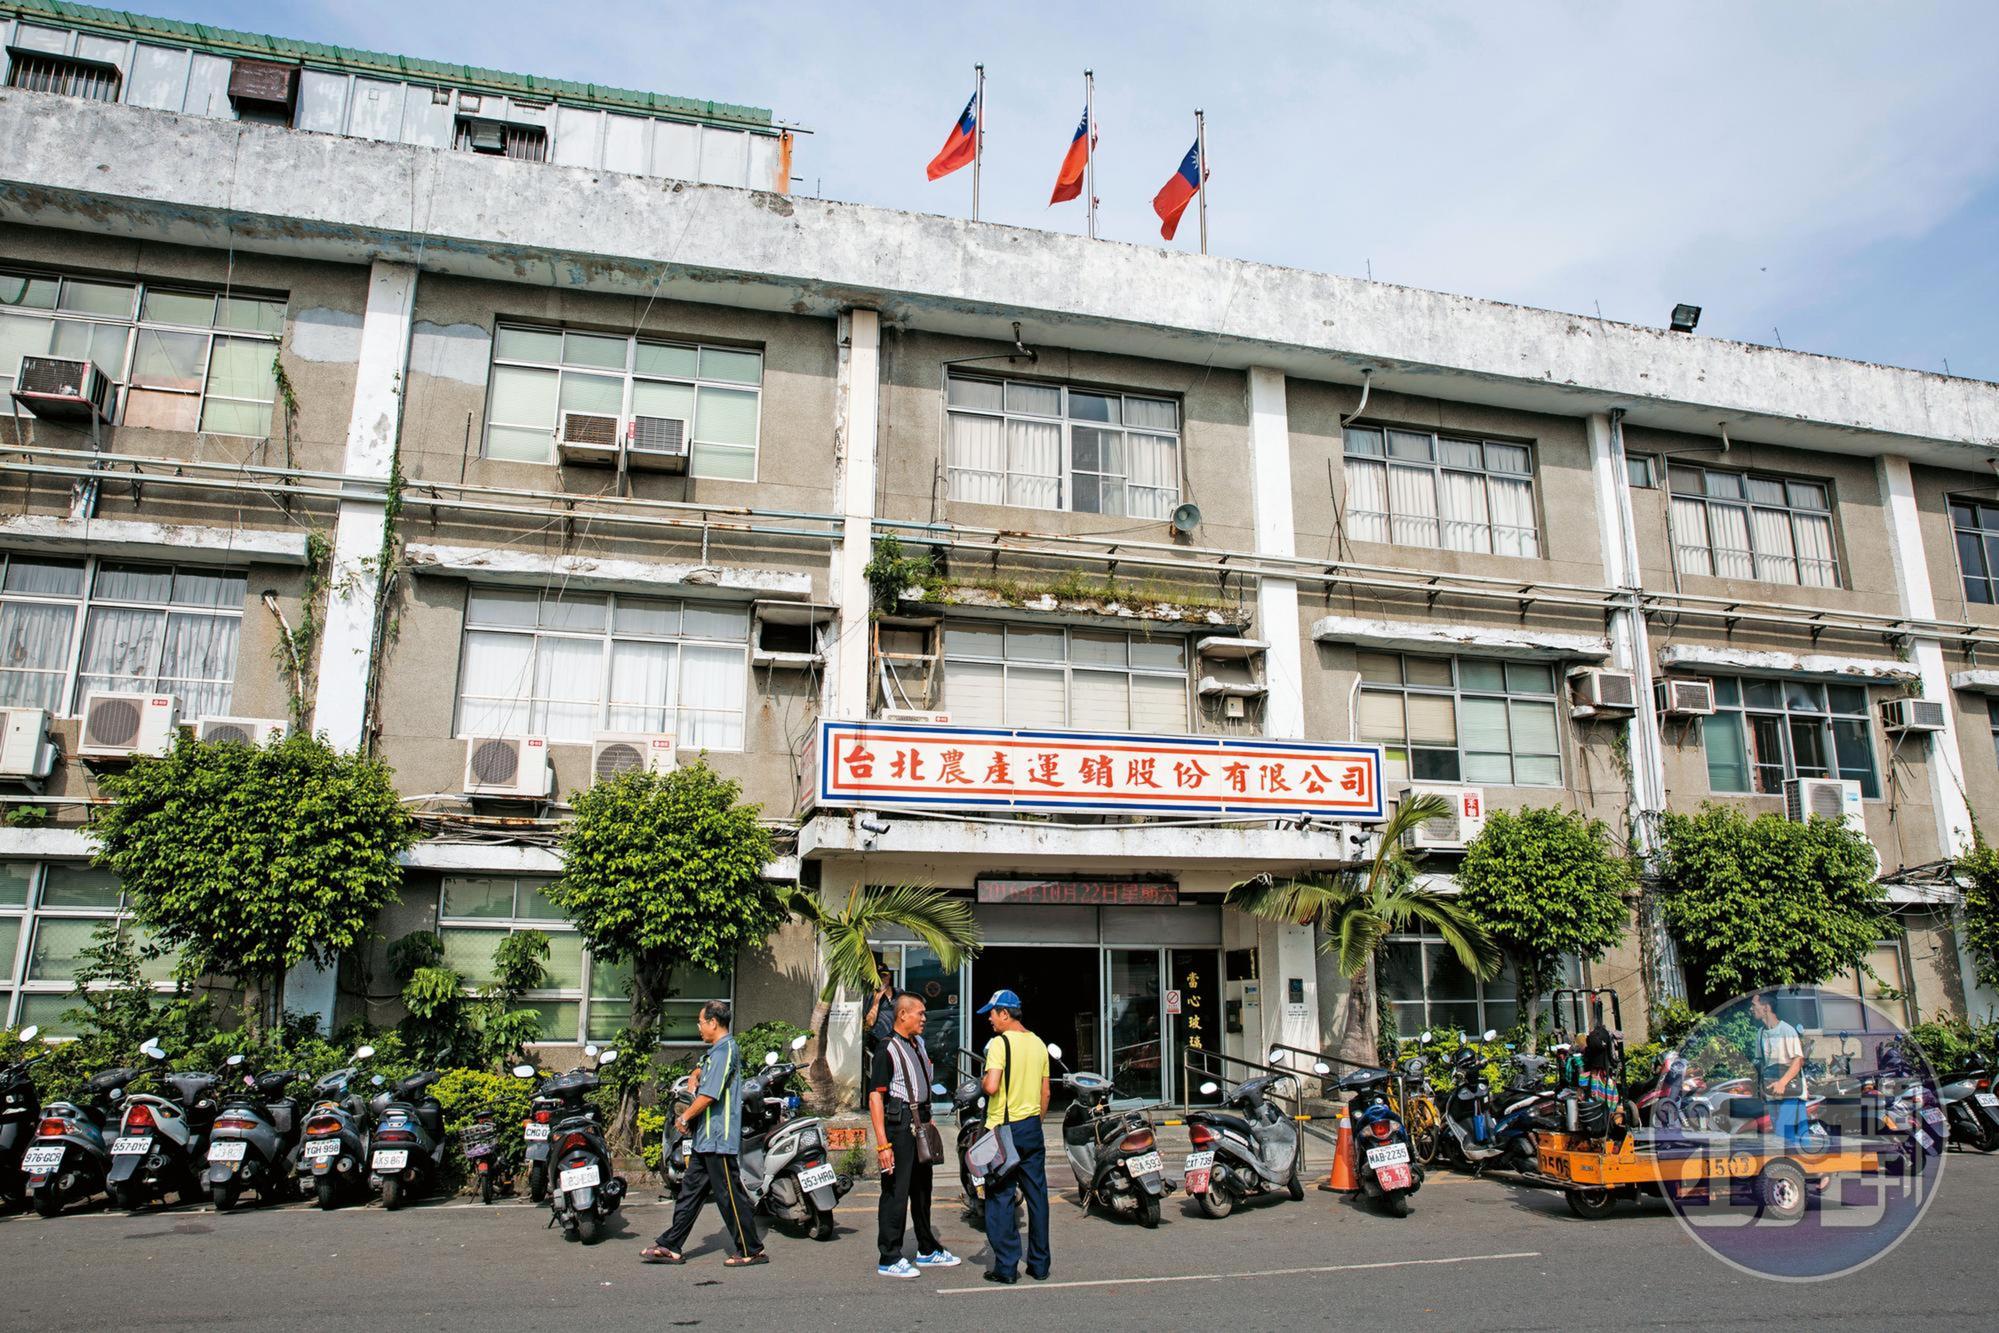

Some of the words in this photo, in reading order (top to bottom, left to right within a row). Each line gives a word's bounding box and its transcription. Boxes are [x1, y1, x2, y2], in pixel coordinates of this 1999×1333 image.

[843, 744, 1365, 797] 台北農產運銷股份有限公司
[1187, 972, 1202, 1050] 當心玻璃
[113, 1142, 150, 1152] 557-DYC
[1368, 1147, 1407, 1165] MAB-2235
[25, 1152, 62, 1163] 976-GCR
[801, 1170, 835, 1189] 353-HRQ
